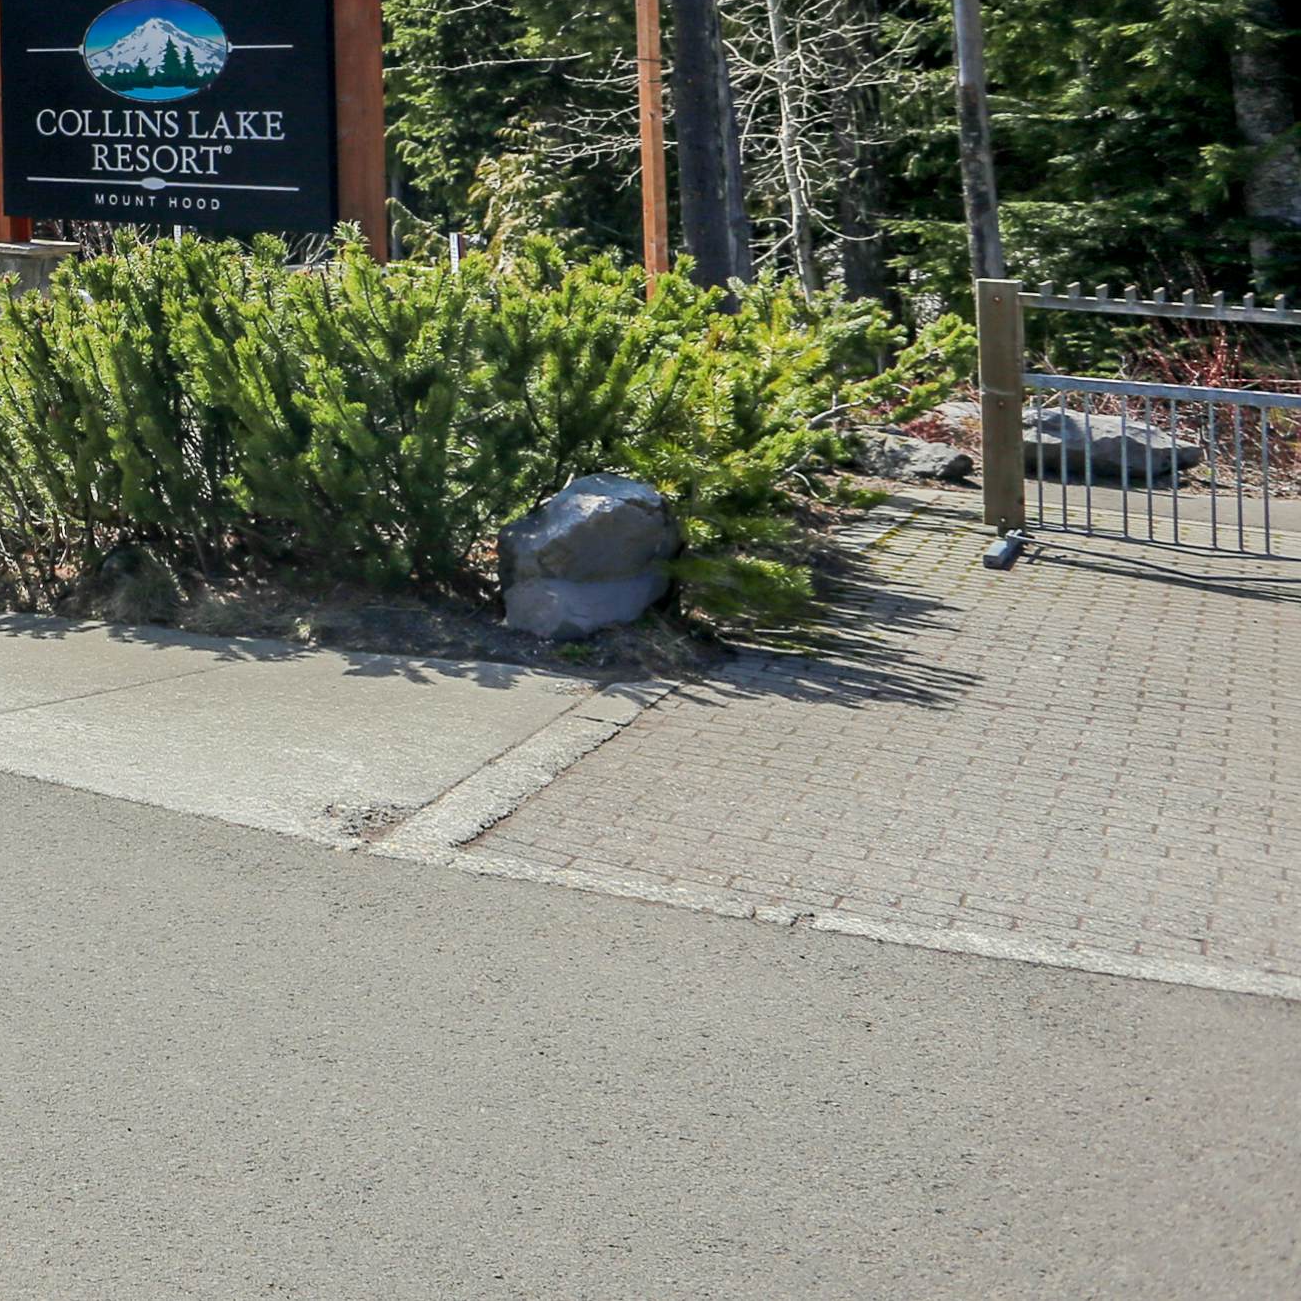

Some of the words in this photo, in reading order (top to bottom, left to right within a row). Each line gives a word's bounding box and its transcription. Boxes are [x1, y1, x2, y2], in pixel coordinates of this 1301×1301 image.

[36, 109, 180, 139] COLLINS
[188, 110, 286, 141] LAKE
[94, 193, 156, 208] MOUNT
[169, 196, 221, 211] HOOD
